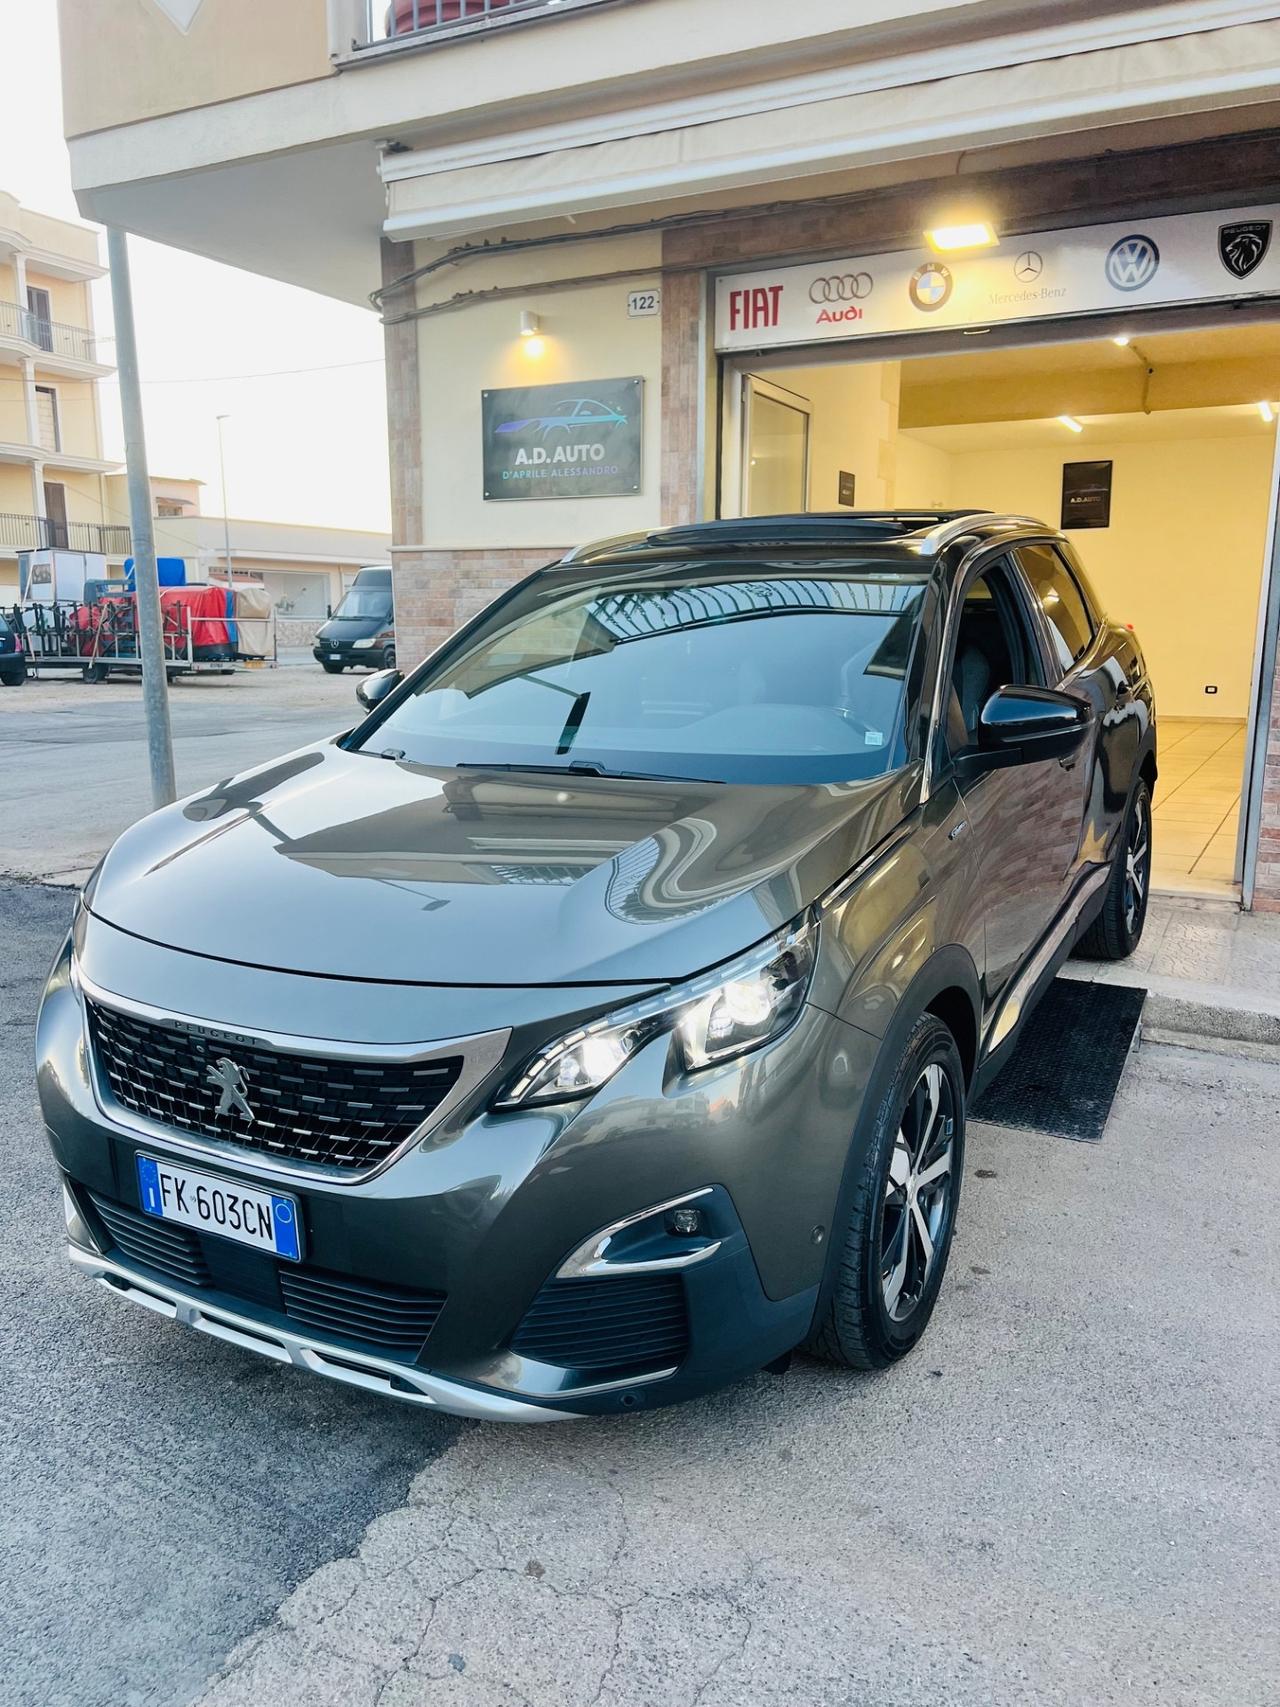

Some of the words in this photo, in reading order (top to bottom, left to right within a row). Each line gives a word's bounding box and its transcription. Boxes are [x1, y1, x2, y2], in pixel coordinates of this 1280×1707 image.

[632, 295, 655, 310] 122
[989, 287, 1067, 305] Mercedes-Benz
[729, 285, 784, 331] FIAT
[816, 305, 863, 324] Audi
[502, 469, 547, 480] D'APRILE
[551, 466, 618, 478] ALESSANDRO
[174, 1020, 257, 1046] PEUGEOT
